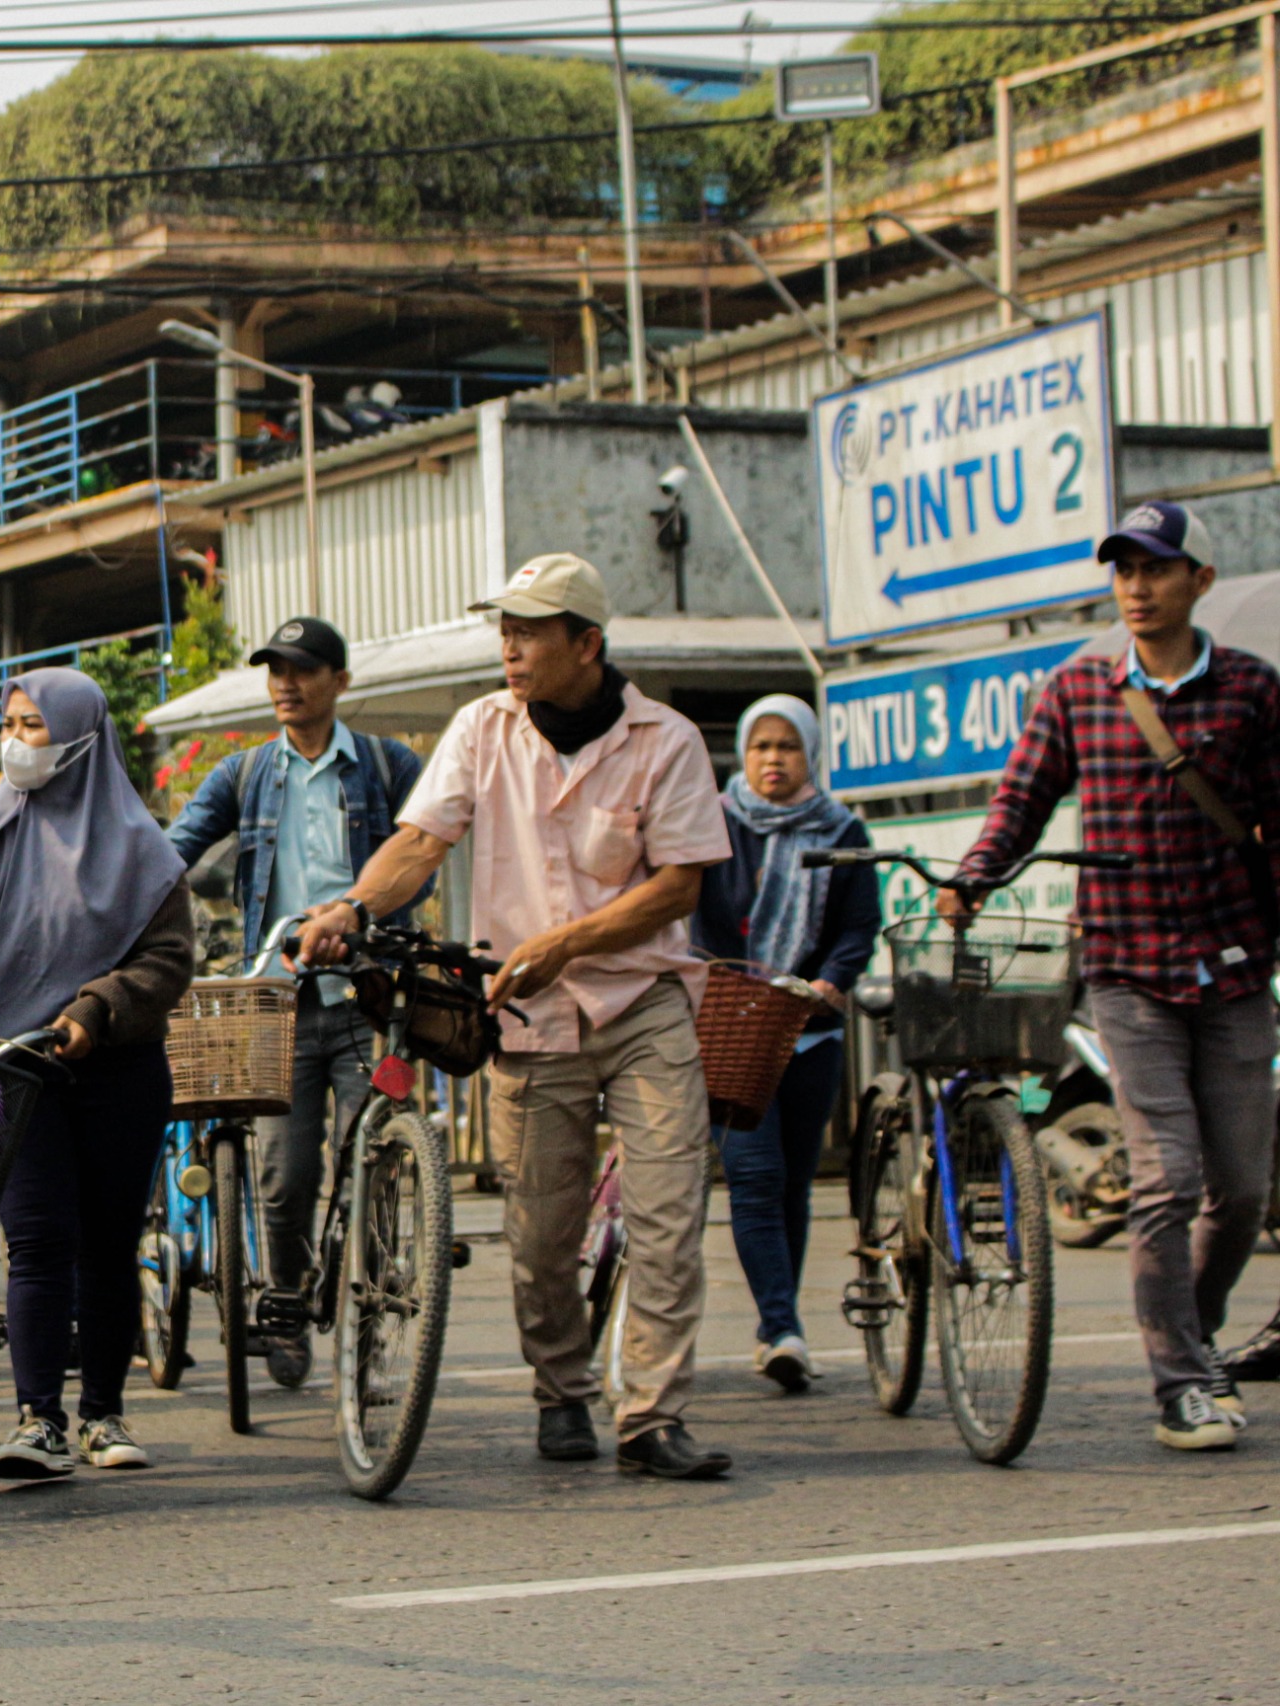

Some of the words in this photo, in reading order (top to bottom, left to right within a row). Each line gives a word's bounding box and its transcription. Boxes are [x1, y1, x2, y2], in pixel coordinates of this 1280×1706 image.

[871, 447, 1024, 557] PINTU
[1051, 431, 1084, 514] 2
[830, 687, 917, 772] PINTU
[923, 684, 950, 758] 3
